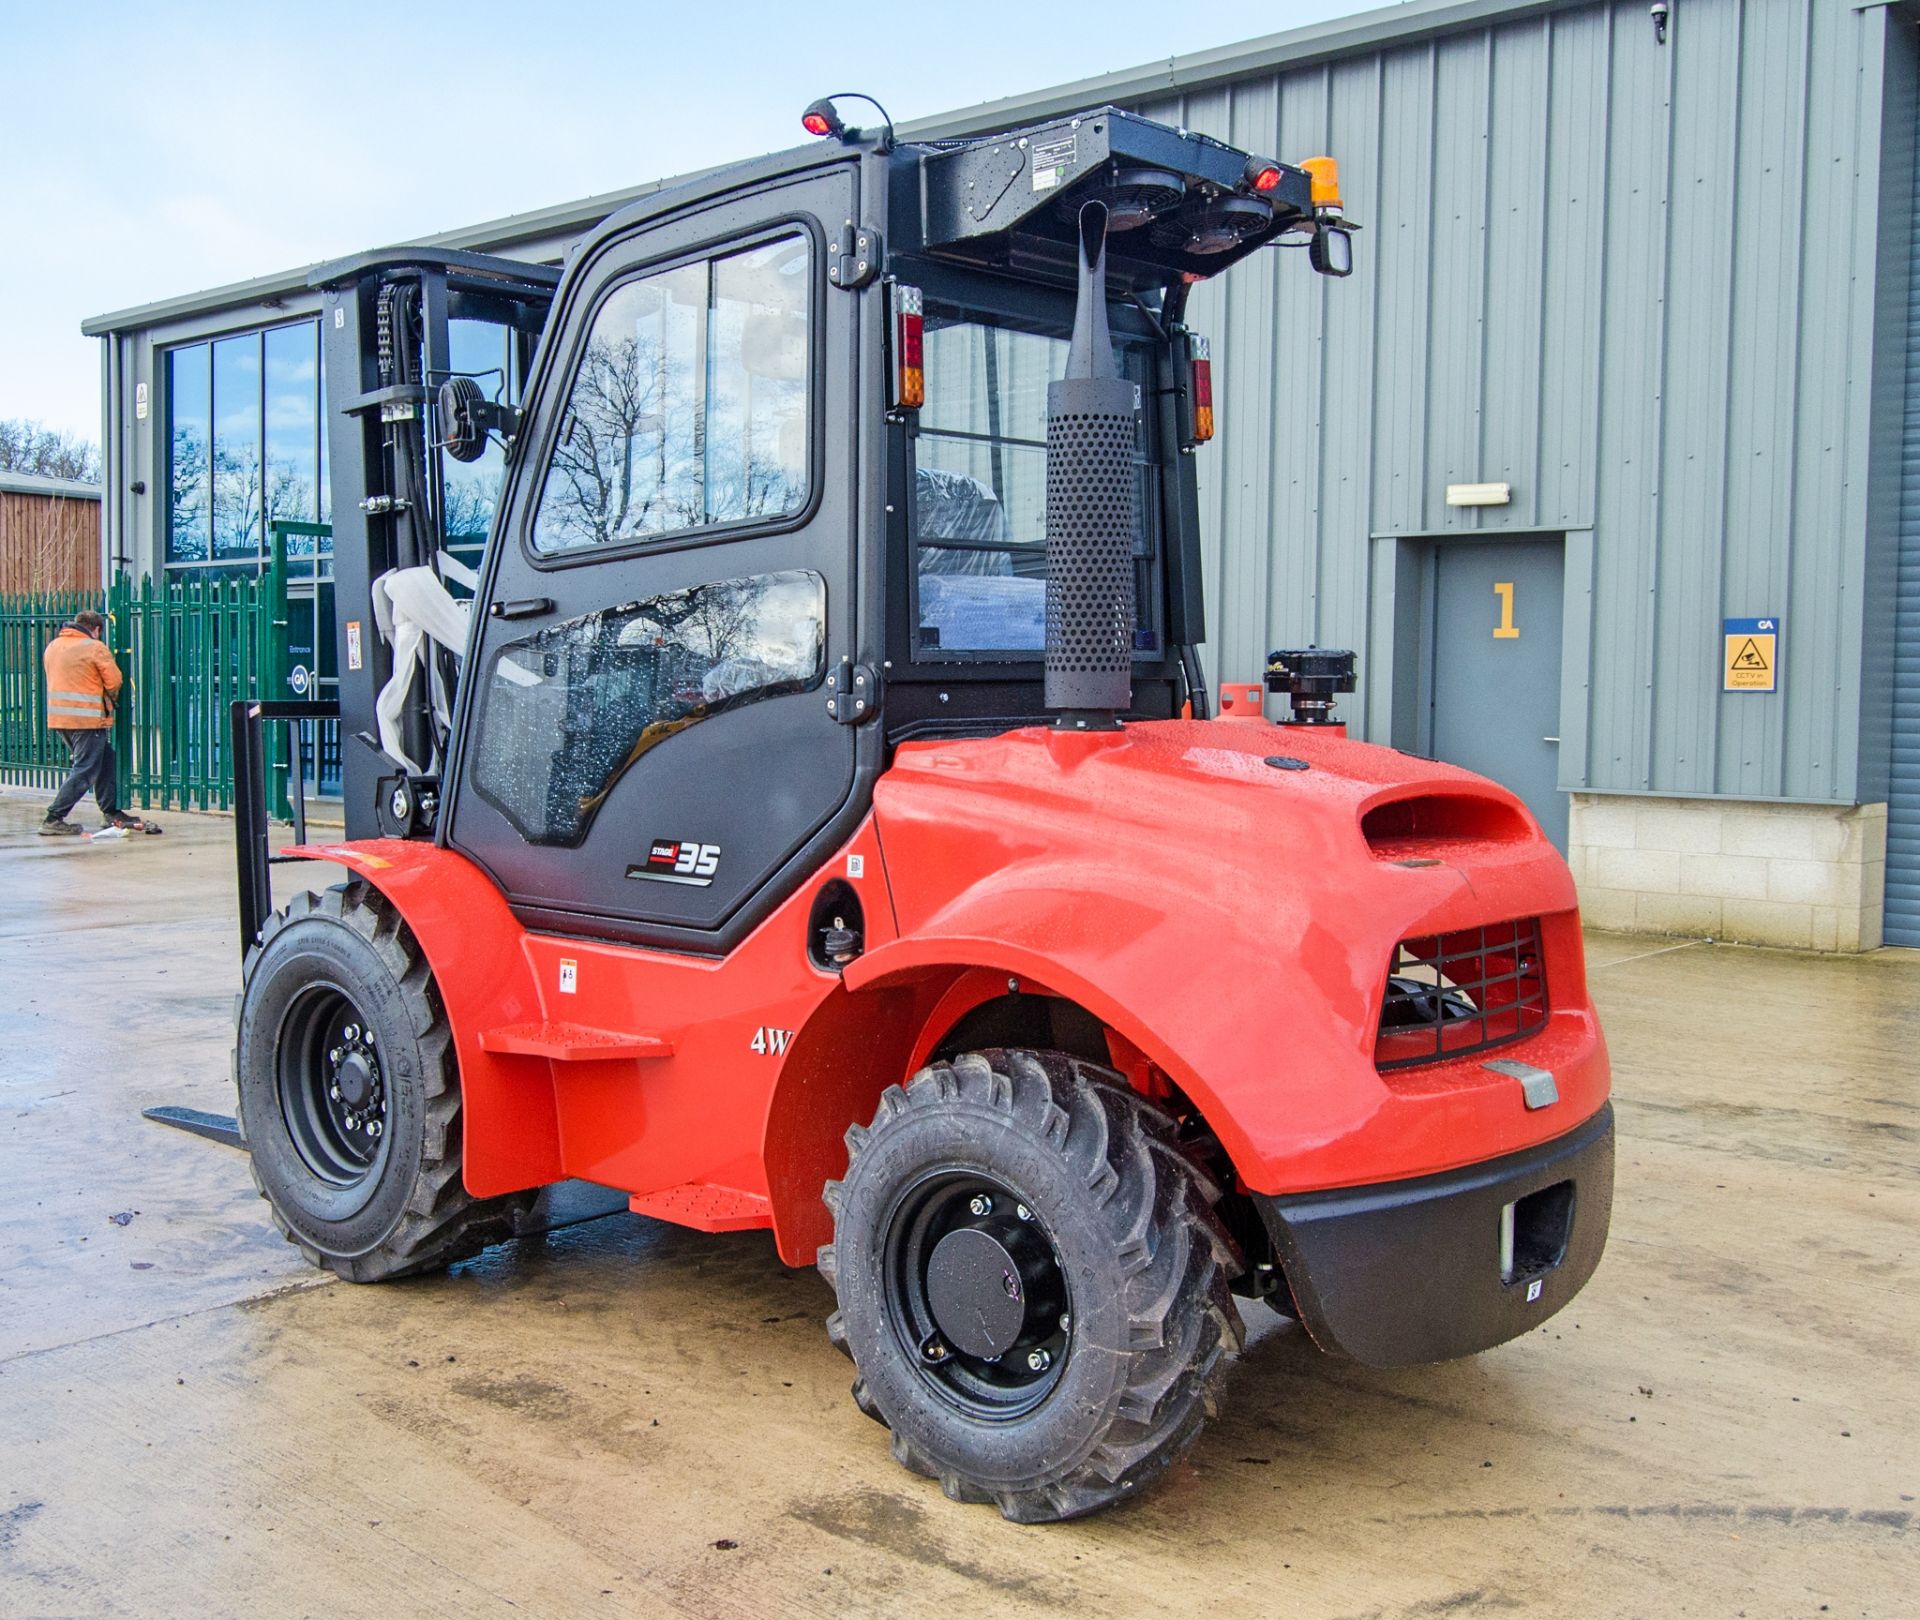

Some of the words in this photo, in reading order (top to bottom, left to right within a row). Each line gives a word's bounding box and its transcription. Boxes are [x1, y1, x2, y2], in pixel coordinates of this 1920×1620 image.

[1493, 582, 1520, 639] 1
[651, 846, 674, 857] STAGE
[674, 842, 721, 876] 35
